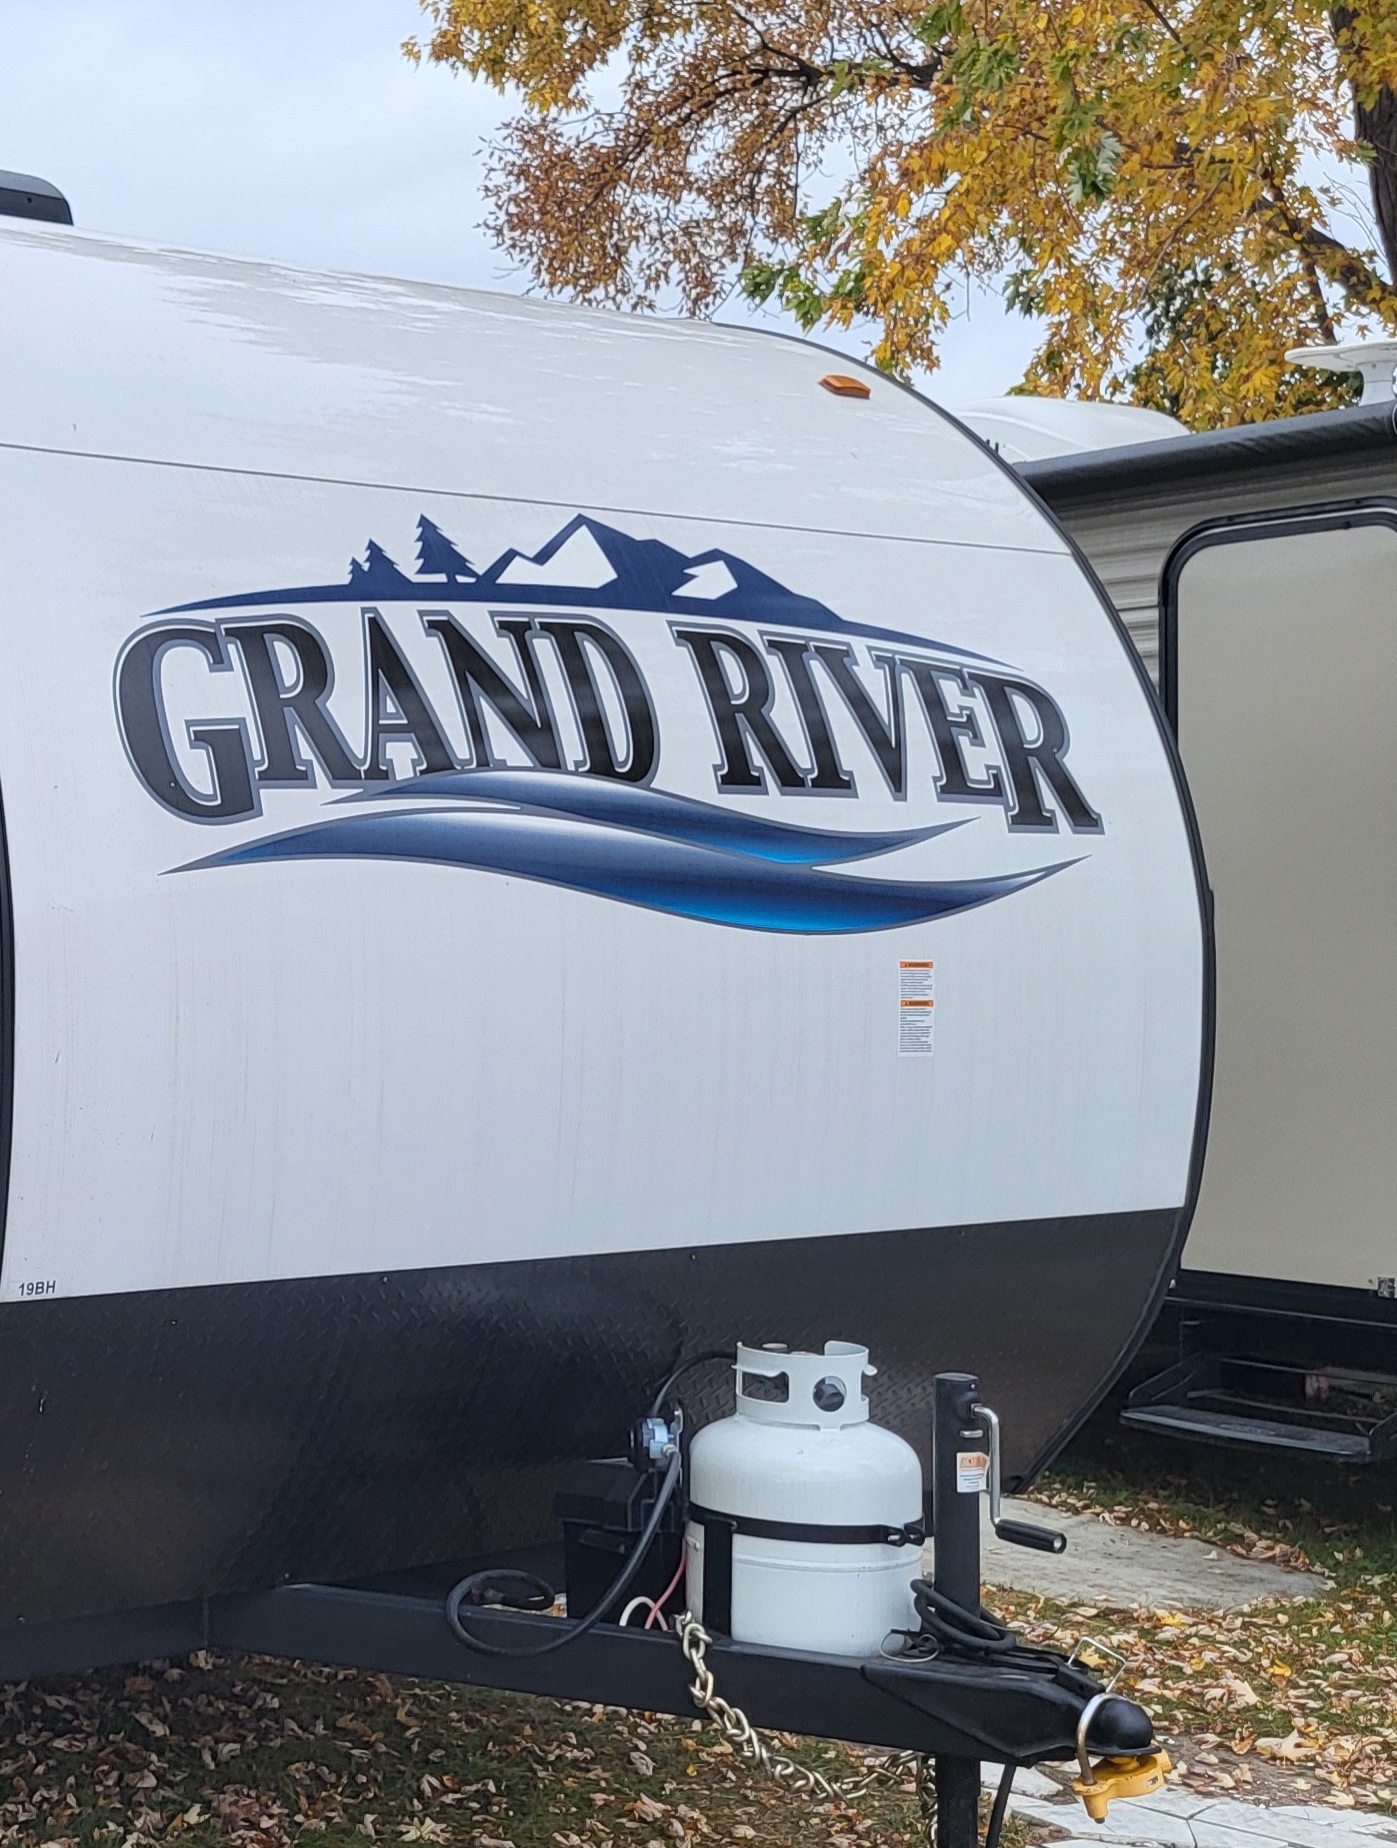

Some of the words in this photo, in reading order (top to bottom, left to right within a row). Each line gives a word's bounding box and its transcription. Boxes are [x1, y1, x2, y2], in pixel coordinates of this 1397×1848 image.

[112, 606, 660, 827] GRAND
[665, 619, 1106, 836] RIVER
[18, 1280, 57, 1297] 19BH
